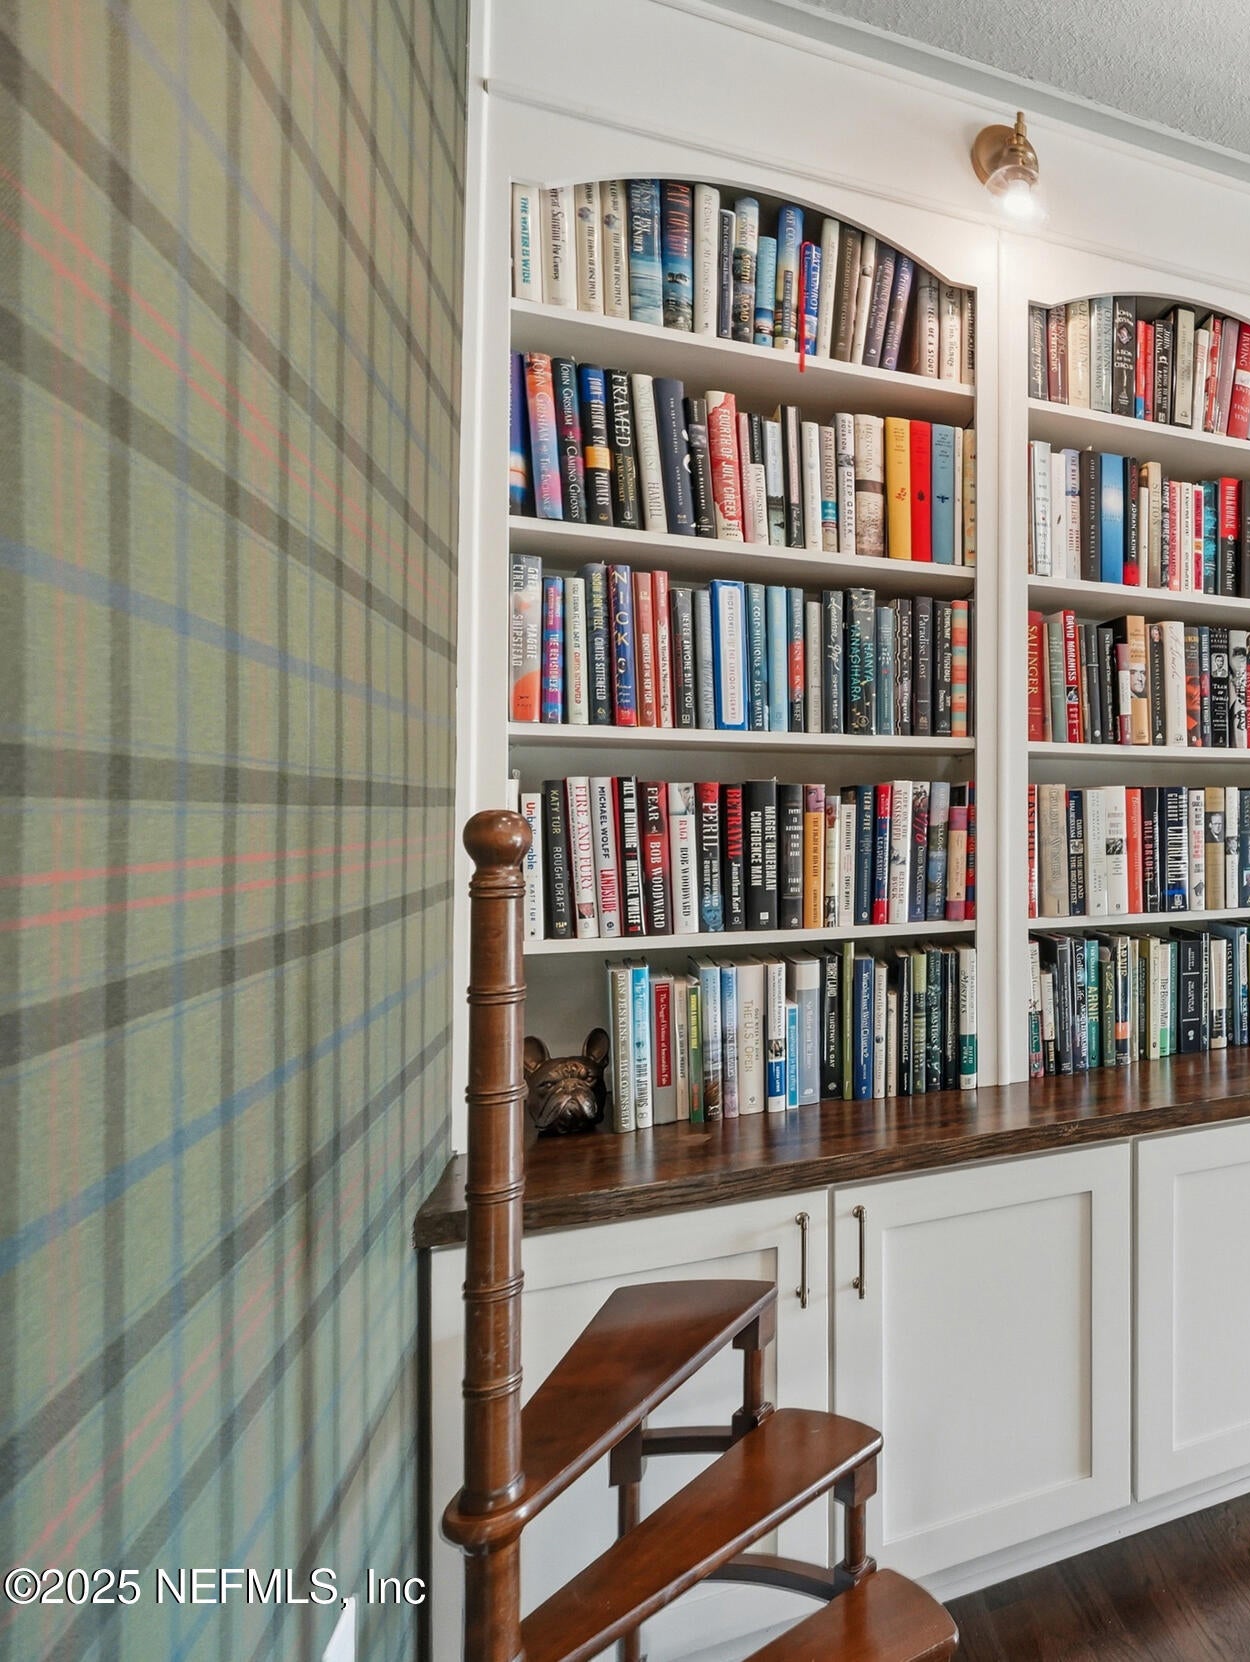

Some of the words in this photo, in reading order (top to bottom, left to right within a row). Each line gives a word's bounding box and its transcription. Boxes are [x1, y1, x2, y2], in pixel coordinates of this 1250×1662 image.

[520, 197, 528, 213] THE
[521, 217, 529, 248] WATER
[522, 259, 530, 284] WIDE
[1240, 332, 1250, 367] IRVING
[532, 358, 547, 387] JOHN
[560, 364, 572, 385] JOHN
[588, 378, 601, 400] JOHN
[536, 392, 551, 441] GRISHAM
[562, 388, 574, 425] GRISHAM
[590, 400, 604, 429] GRISHAM
[611, 374, 631, 447] FRAMED
[718, 409, 730, 447] FOURTH
[566, 446, 577, 482] CAMINO
[721, 448, 733, 460] OF
[723, 461, 735, 486] JULY
[825, 455, 835, 498] HOUSTON
[569, 484, 581, 519] GHOSTS
[647, 482, 658, 519] HAMILL
[723, 487, 737, 517] CREEK
[526, 624, 538, 659] MAGGIE
[550, 634, 559, 647] THE
[918, 614, 928, 656] Paradise
[1065, 615, 1076, 638] DAVID
[594, 637, 604, 661] CURTIS
[850, 623, 861, 702] YANAGIHARA
[864, 642, 873, 683] HANYA
[1028, 625, 1039, 695] SALINGER
[595, 663, 606, 700] SITTENFELD
[918, 658, 928, 678] Lost
[684, 692, 693, 708] YOU
[550, 789, 561, 813] KATY
[574, 786, 587, 816] FIRE
[623, 781, 636, 797] ALL
[647, 788, 659, 821] FEAR
[597, 786, 607, 826] MICHAEL
[526, 802, 537, 870] Unbable
[551, 816, 561, 835] TUR
[577, 819, 590, 851] AND
[624, 811, 638, 848] NOTHING
[679, 820, 688, 842] RAGE
[703, 803, 720, 852] PERIL
[726, 788, 742, 861] BETRAYAL
[750, 811, 762, 863] CONFIDENCE
[765, 806, 776, 840] MAGGIE
[1143, 820, 1153, 840] BILL
[600, 828, 610, 860] WOLFF
[650, 842, 662, 864] BOB
[680, 848, 689, 866] BOB
[553, 847, 564, 880] ROUGH
[579, 855, 593, 892] FURY
[625, 860, 640, 894] MICHAEL
[751, 866, 762, 886] MAN
[765, 842, 777, 891] HABERMAN
[555, 883, 565, 912] DRAFT
[600, 869, 616, 914] LANDSLIDE
[651, 867, 665, 929] WOODWARD
[681, 868, 691, 917] WOODWARD
[627, 898, 641, 925] WOLFF
[743, 1000, 753, 1018] THE
[1087, 986, 1099, 1022] ARNIE
